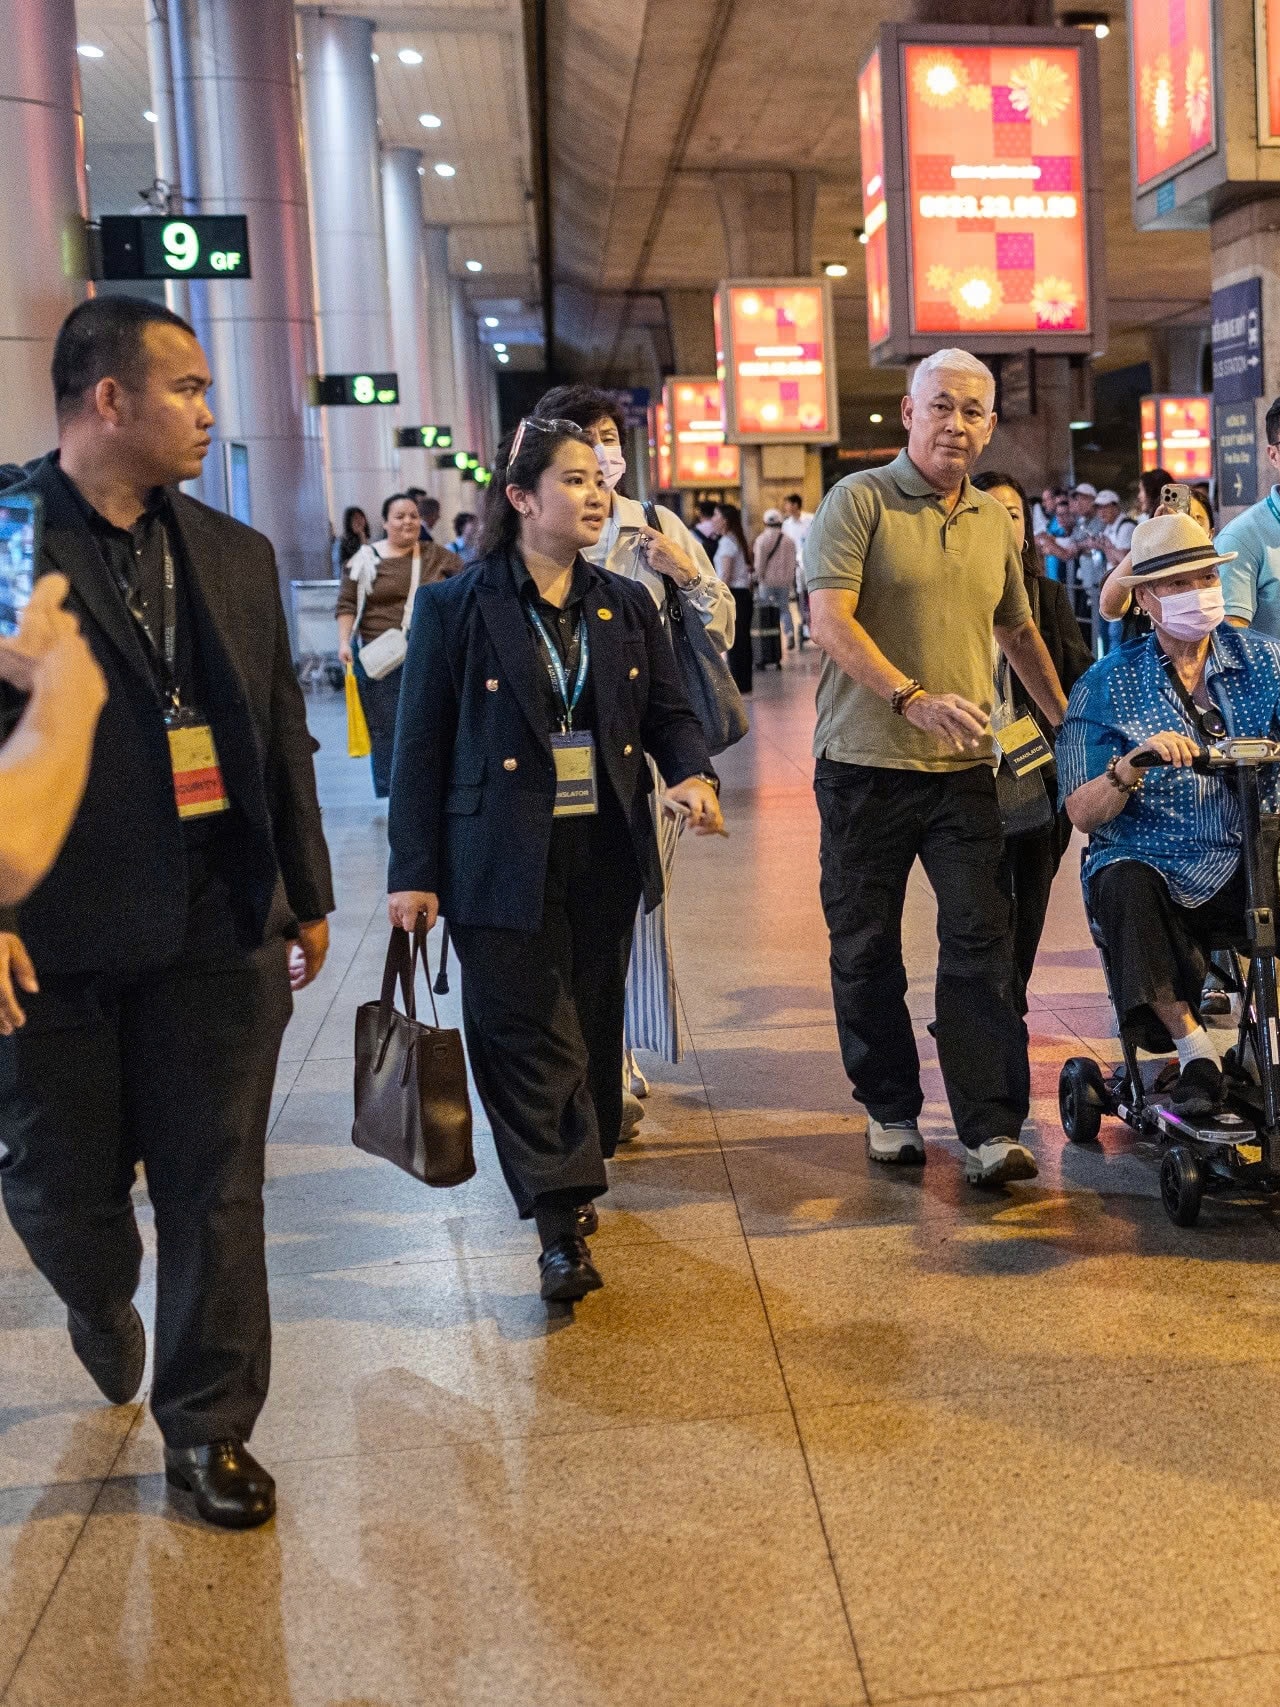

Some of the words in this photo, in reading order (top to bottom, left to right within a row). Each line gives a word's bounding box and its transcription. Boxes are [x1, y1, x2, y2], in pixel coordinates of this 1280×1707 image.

[163, 222, 199, 271] 9
[210, 252, 241, 271] GF
[354, 376, 375, 403] 8
[421, 427, 438, 448] 7
[1013, 745, 1044, 764] TRANSLATOR
